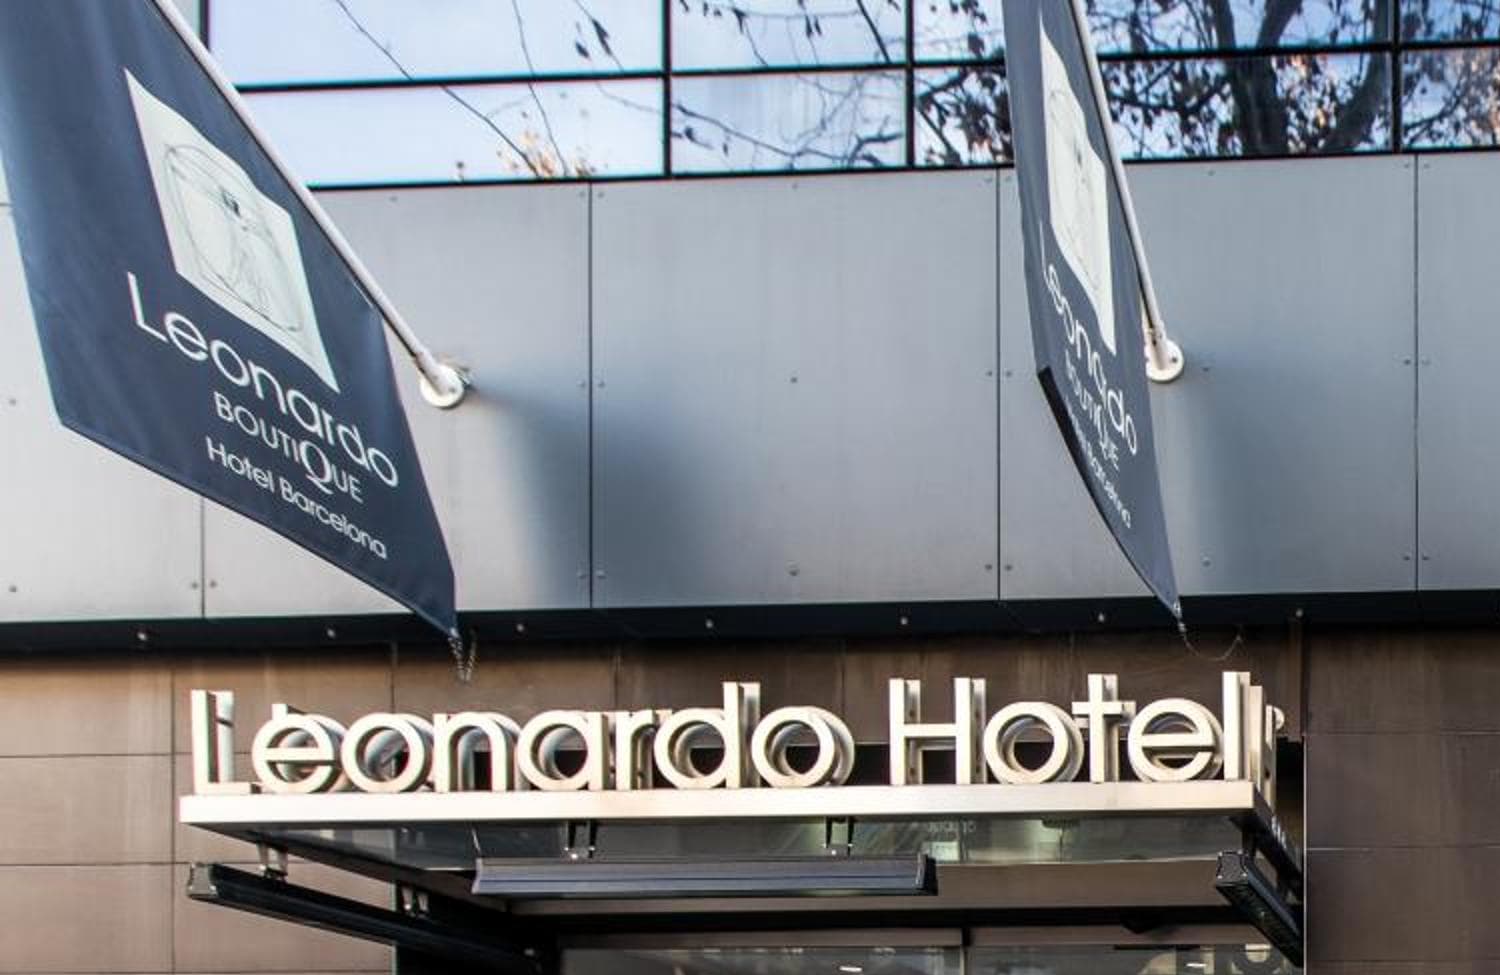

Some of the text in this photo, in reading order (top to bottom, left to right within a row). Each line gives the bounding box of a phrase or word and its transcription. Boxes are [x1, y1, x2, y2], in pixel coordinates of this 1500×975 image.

[127, 271, 398, 487] Leonardo
[205, 435, 388, 560] Hotel Barcelona
[213, 390, 364, 503] BOUTIQUE
[190, 671, 1245, 795] Leonardo Hotel
